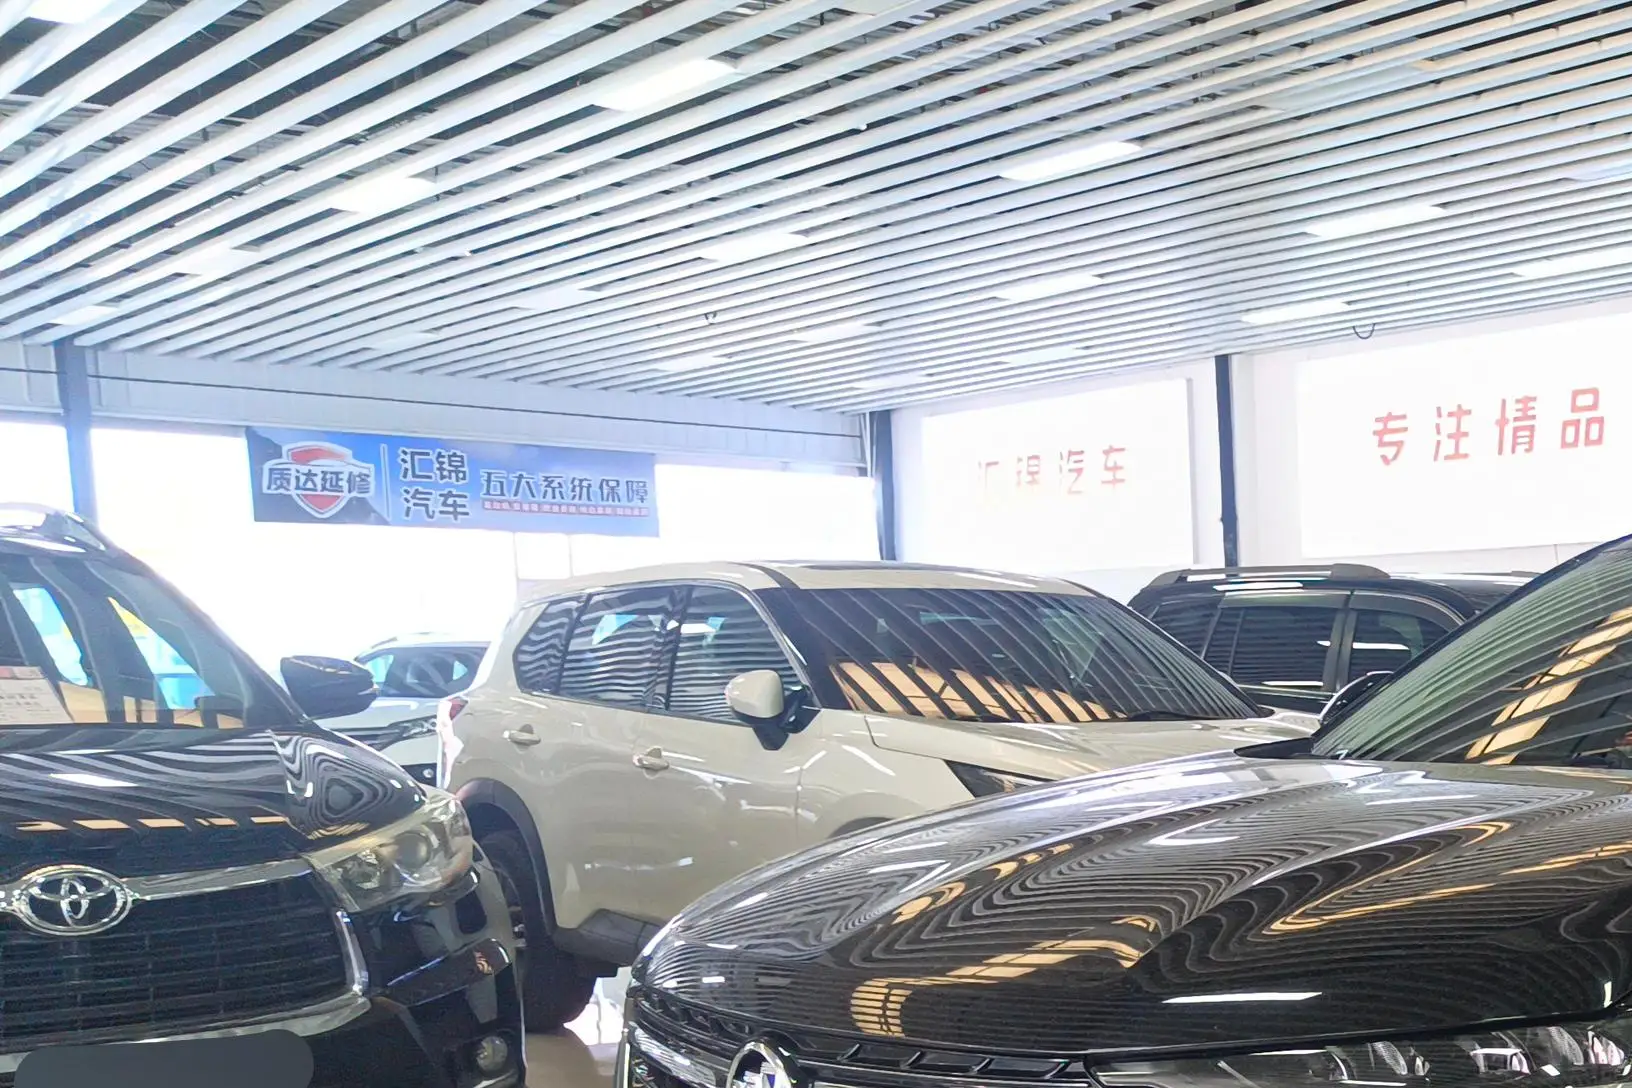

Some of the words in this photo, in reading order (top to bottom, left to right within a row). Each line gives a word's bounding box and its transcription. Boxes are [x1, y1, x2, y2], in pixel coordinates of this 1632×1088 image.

[266, 467, 372, 495] 质达延修
[400, 448, 468, 483] 汇锦
[403, 487, 470, 521] 汽车
[481, 470, 650, 504] 五大系统保障
